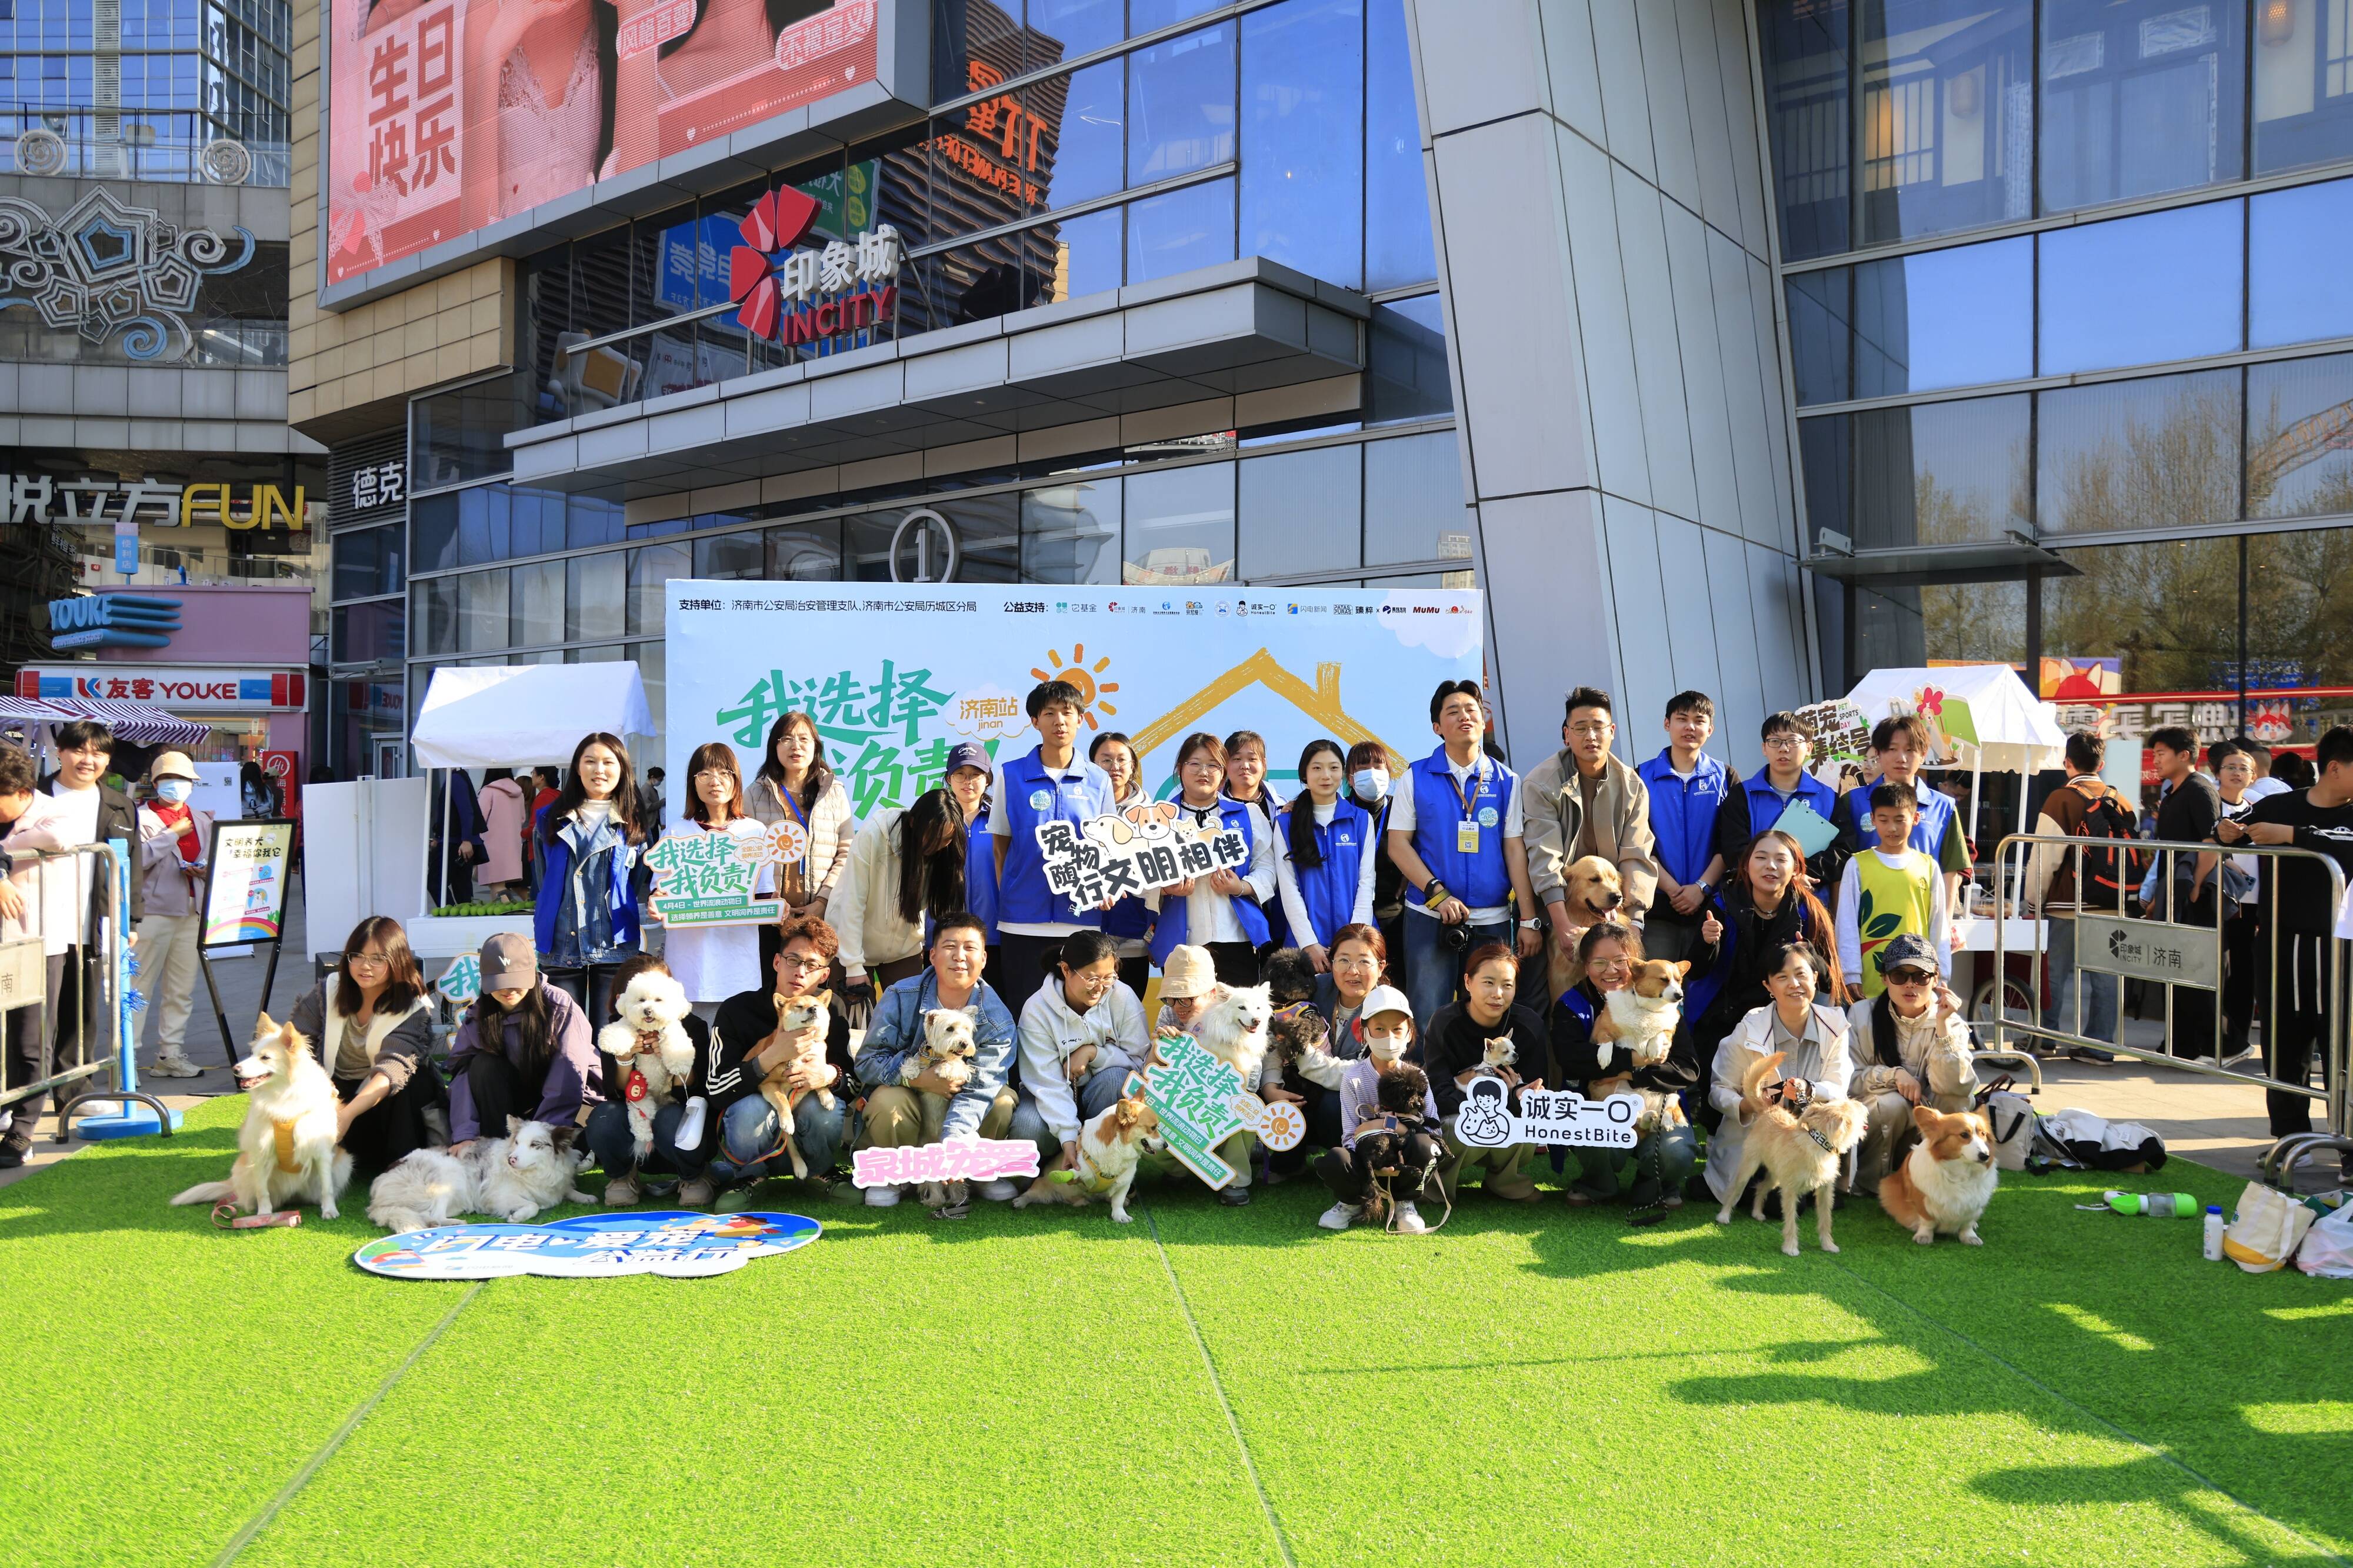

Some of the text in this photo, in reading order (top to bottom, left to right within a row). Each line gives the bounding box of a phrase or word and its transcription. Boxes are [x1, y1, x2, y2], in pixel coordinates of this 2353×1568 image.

[781, 2, 868, 65] 不被定义
[369, 5, 454, 125] 生日
[369, 93, 456, 196] 快乐
[782, 223, 898, 302] 印象城
[784, 285, 897, 347] INCITY
[182, 483, 305, 531] FUN
[122, 539, 132, 569] 便利店
[49, 594, 113, 631] YOUKE
[106, 677, 237, 699] 友客 YOUKE
[716, 659, 956, 749] 我选择
[1838, 702, 1848, 710] PET
[959, 696, 1018, 719] 济南站
[978, 718, 1004, 732] jinan
[1839, 709, 1858, 720] SPORTS
[1840, 720, 1851, 729] DAY
[225, 836, 264, 848] 文明养犬
[232, 847, 281, 859] 幸福你我它
[647, 833, 738, 870] 我选择
[1041, 825, 1100, 870] 宠物
[660, 862, 757, 899] 我负责!
[1049, 860, 1104, 906] 随行
[1098, 834, 1245, 896] 文明相伴
[671, 906, 775, 922] 选择领养是善意 文明饲养是责任
[693, 898, 742, 908] 世界流浪动物日
[2120, 943, 2142, 955] 印象城
[2120, 955, 2142, 964] INCITY
[2154, 947, 2182, 969] 济南
[1159, 1036, 1240, 1099] 我选择
[1148, 1066, 1242, 1139] 我负责!
[1526, 1095, 1631, 1123] 诚实一口
[1159, 1106, 1203, 1145] 世界流浪动物日
[1525, 1125, 1631, 1143] HonestBite
[857, 1140, 1038, 1185] 泉城宠爱
[1176, 1137, 1224, 1178] 文明饲养是责任
[419, 1229, 706, 1253] 闪电 爱宠
